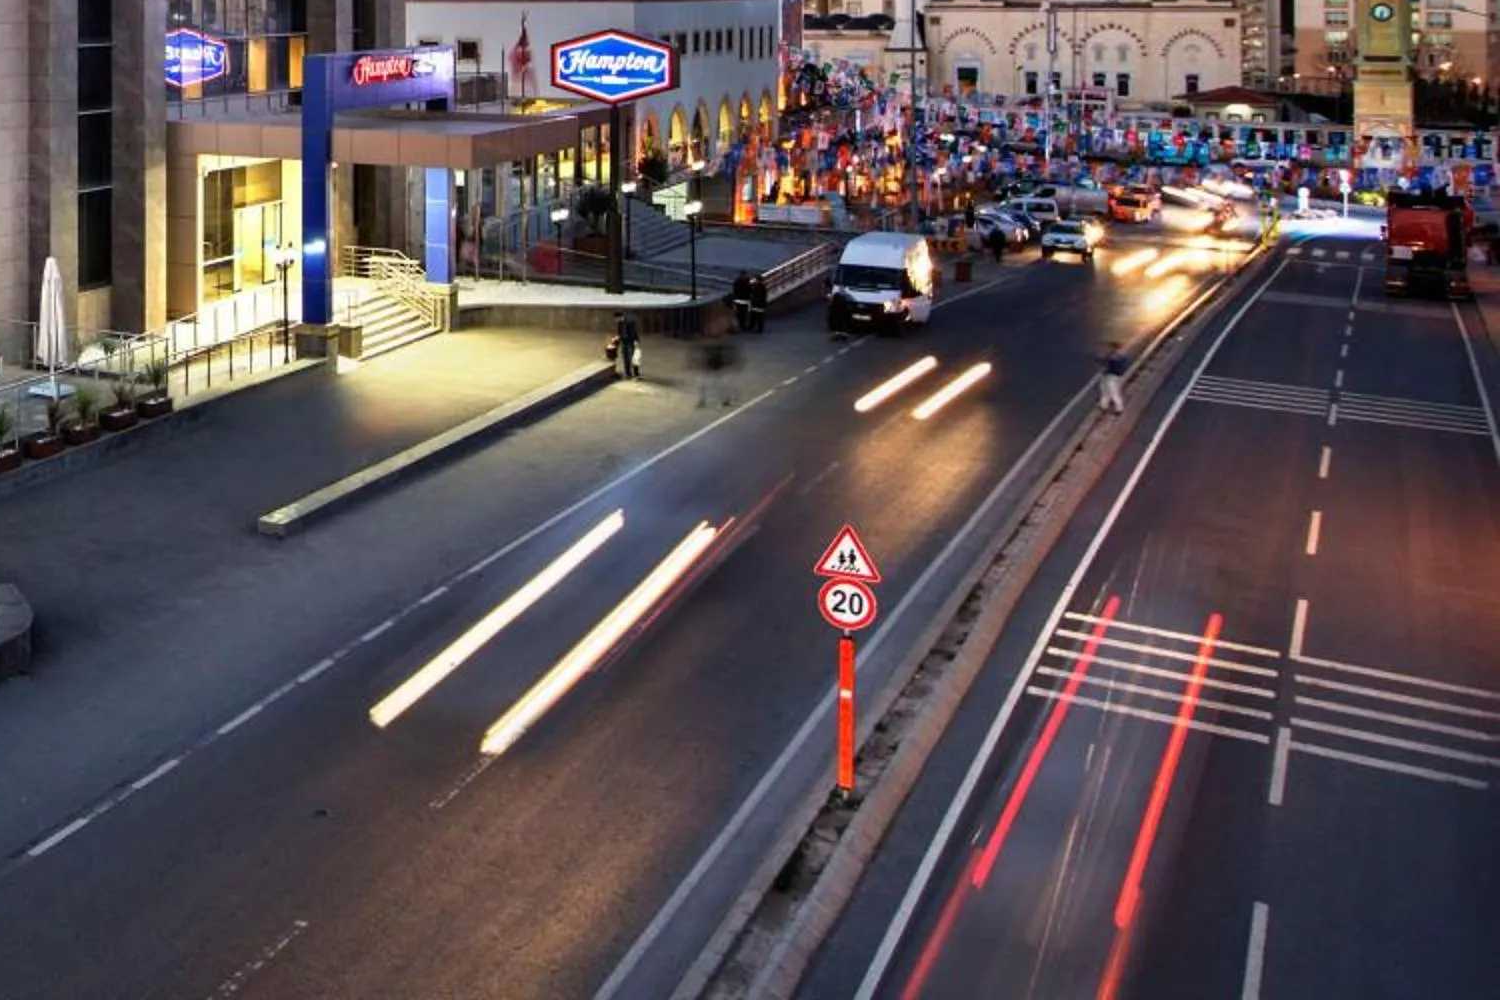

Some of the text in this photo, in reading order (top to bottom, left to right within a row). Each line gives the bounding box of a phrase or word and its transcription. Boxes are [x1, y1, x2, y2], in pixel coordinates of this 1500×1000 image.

[354, 55, 411, 85] Hampton
[560, 49, 665, 75] Hampton
[832, 589, 863, 616] 20
